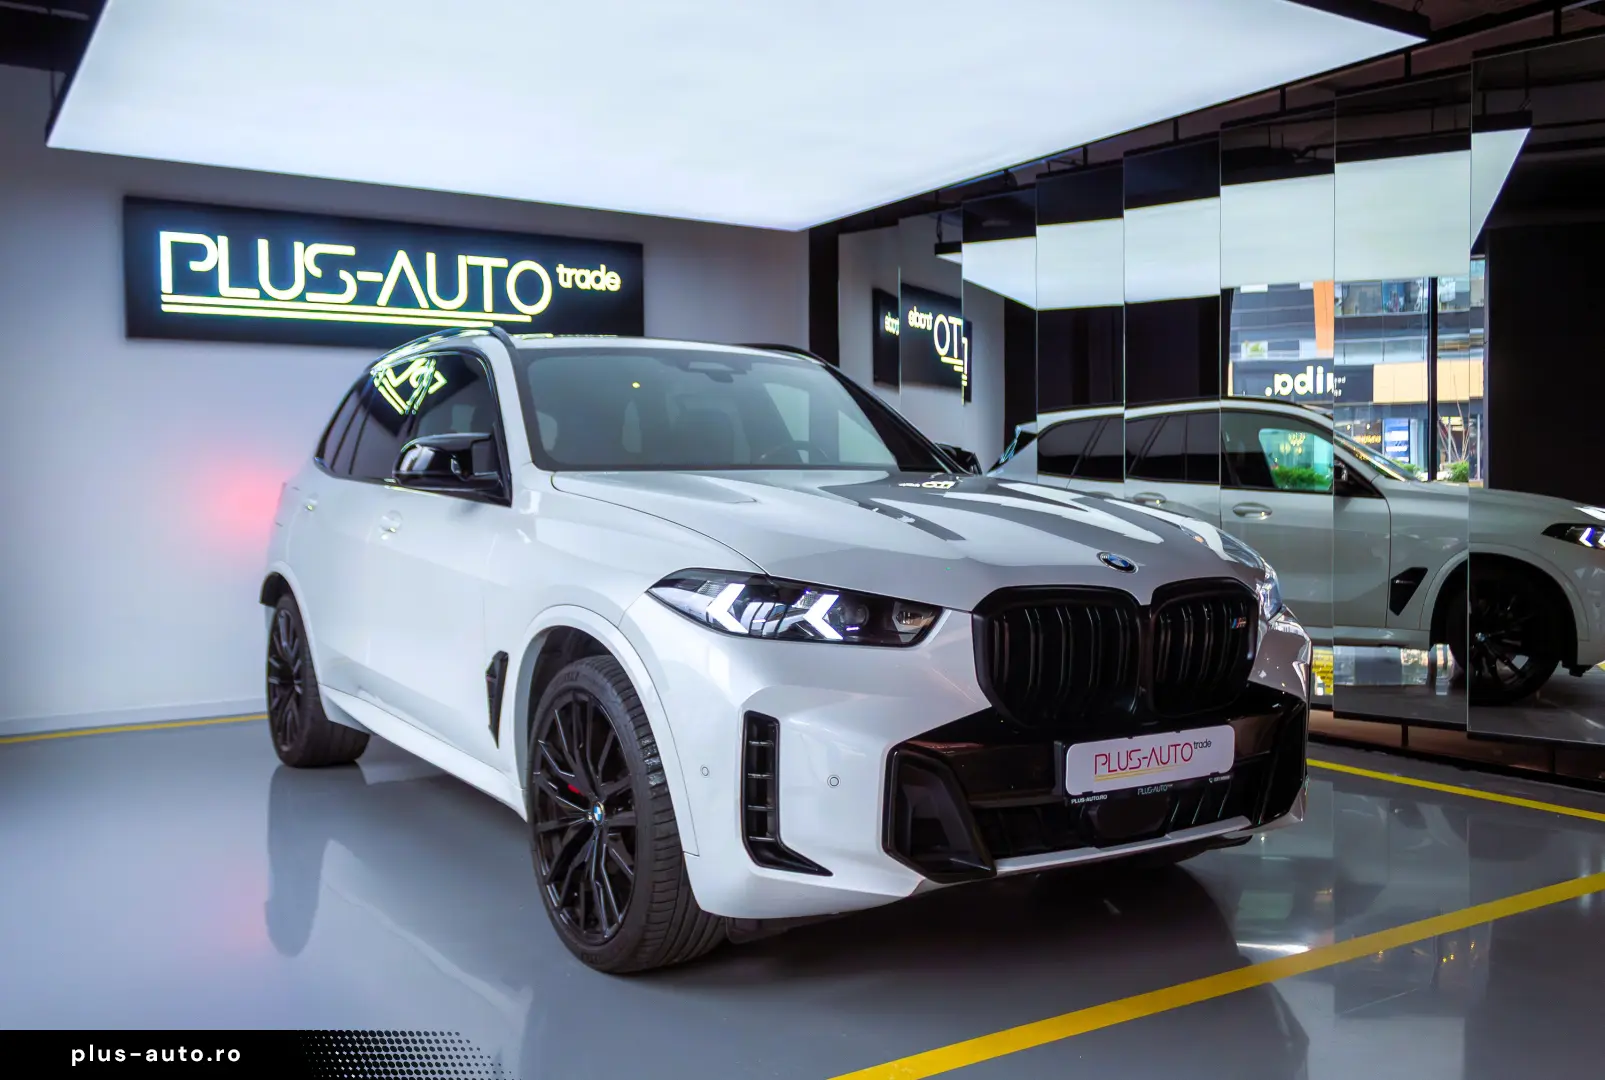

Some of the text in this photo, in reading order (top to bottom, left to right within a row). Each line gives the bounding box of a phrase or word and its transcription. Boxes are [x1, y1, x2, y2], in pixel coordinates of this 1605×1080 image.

[159, 231, 622, 316] PLUS-AUTO trade
[1094, 738, 1212, 775] PLUS-AUTO trade
